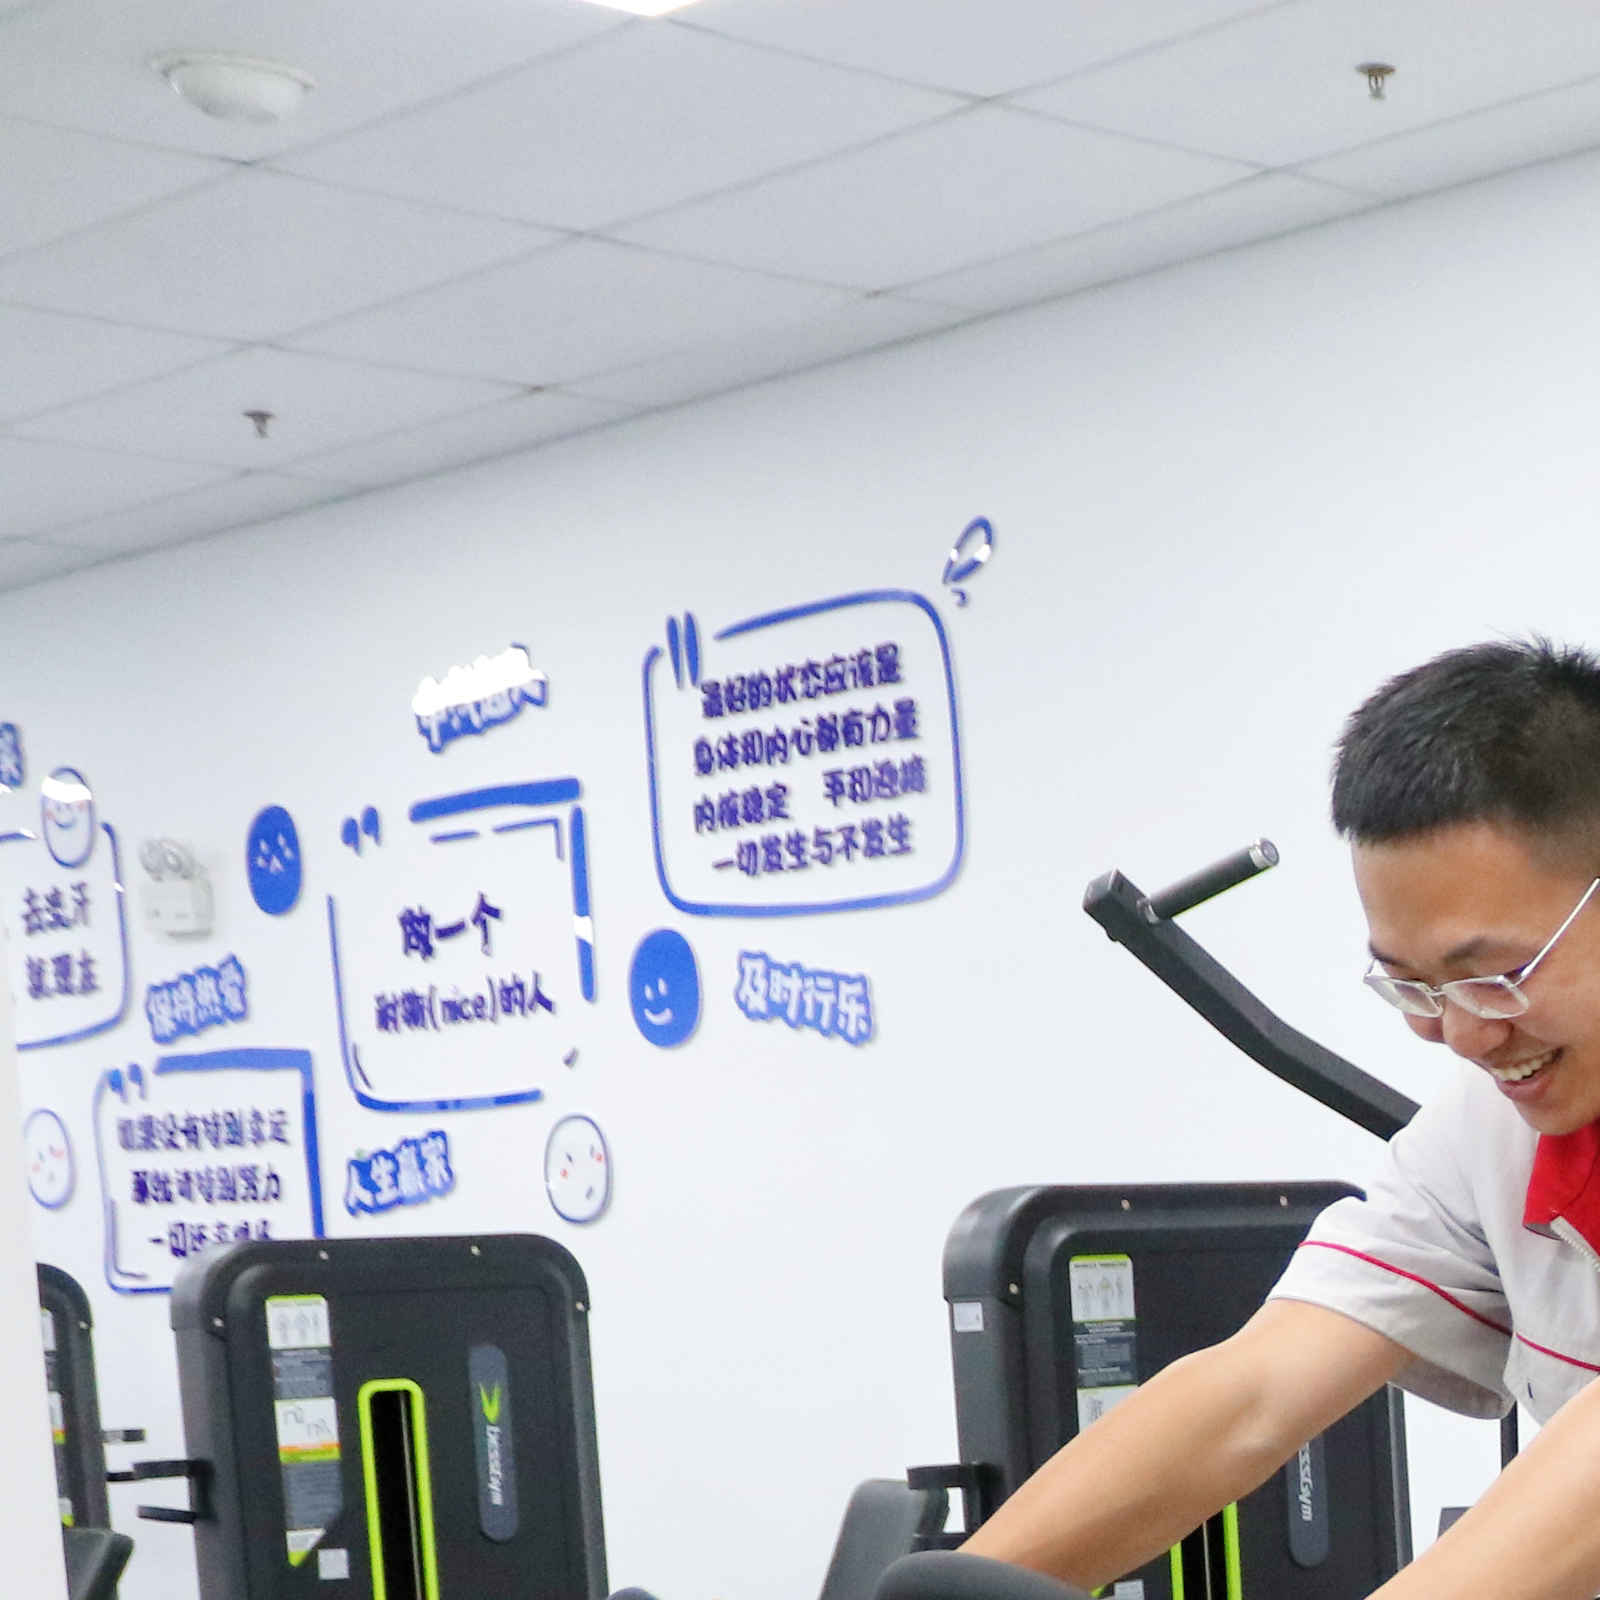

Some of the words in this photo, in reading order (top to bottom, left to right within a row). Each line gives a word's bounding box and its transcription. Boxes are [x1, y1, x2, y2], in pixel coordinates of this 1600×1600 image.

[712, 811, 913, 878] 一切发生与不发生
[734, 949, 875, 1046] 及时行乐
